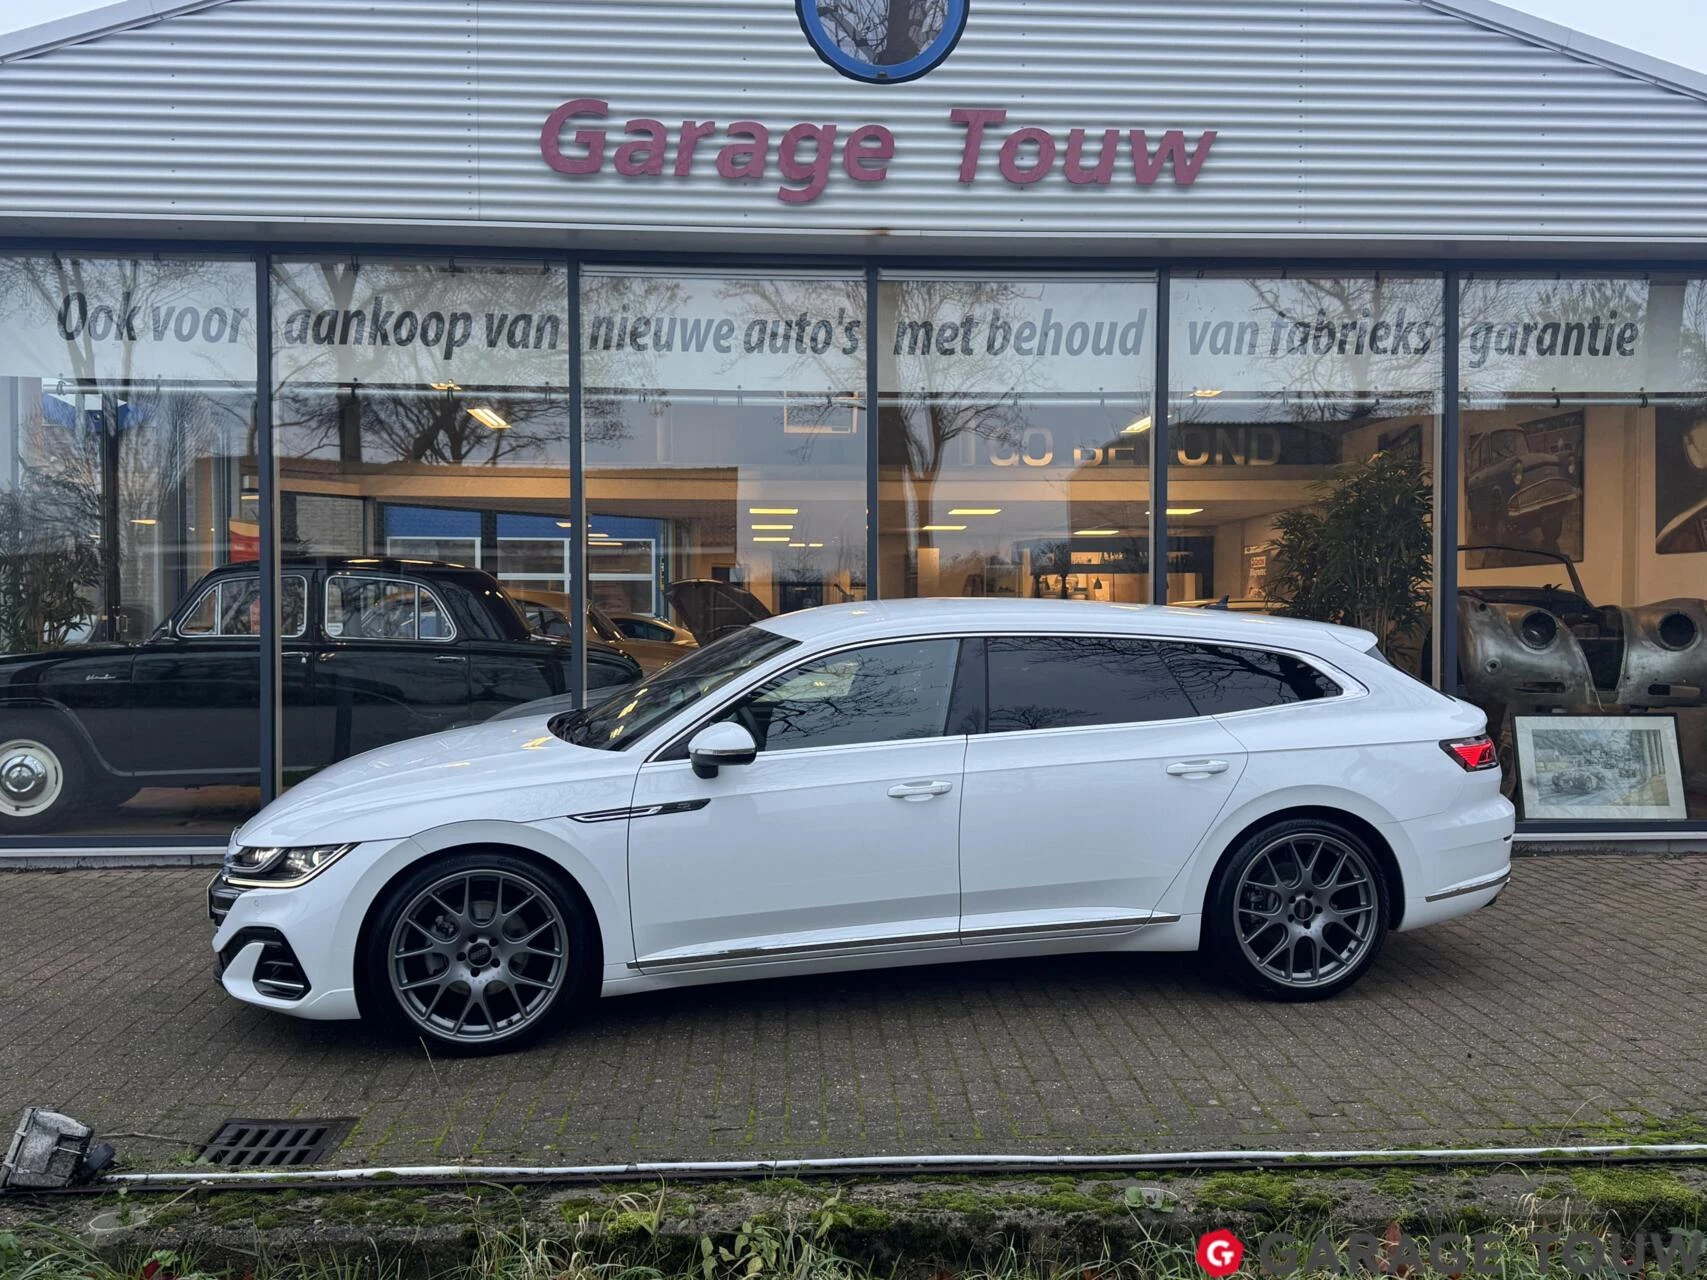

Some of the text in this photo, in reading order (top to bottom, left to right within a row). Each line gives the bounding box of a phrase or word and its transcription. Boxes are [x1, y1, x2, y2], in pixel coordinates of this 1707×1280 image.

[540, 97, 1218, 203] Garage Touw
[57, 292, 1639, 368] Ook voor aankoop van nieuwe auto's met behoud van fabrieks garantie
